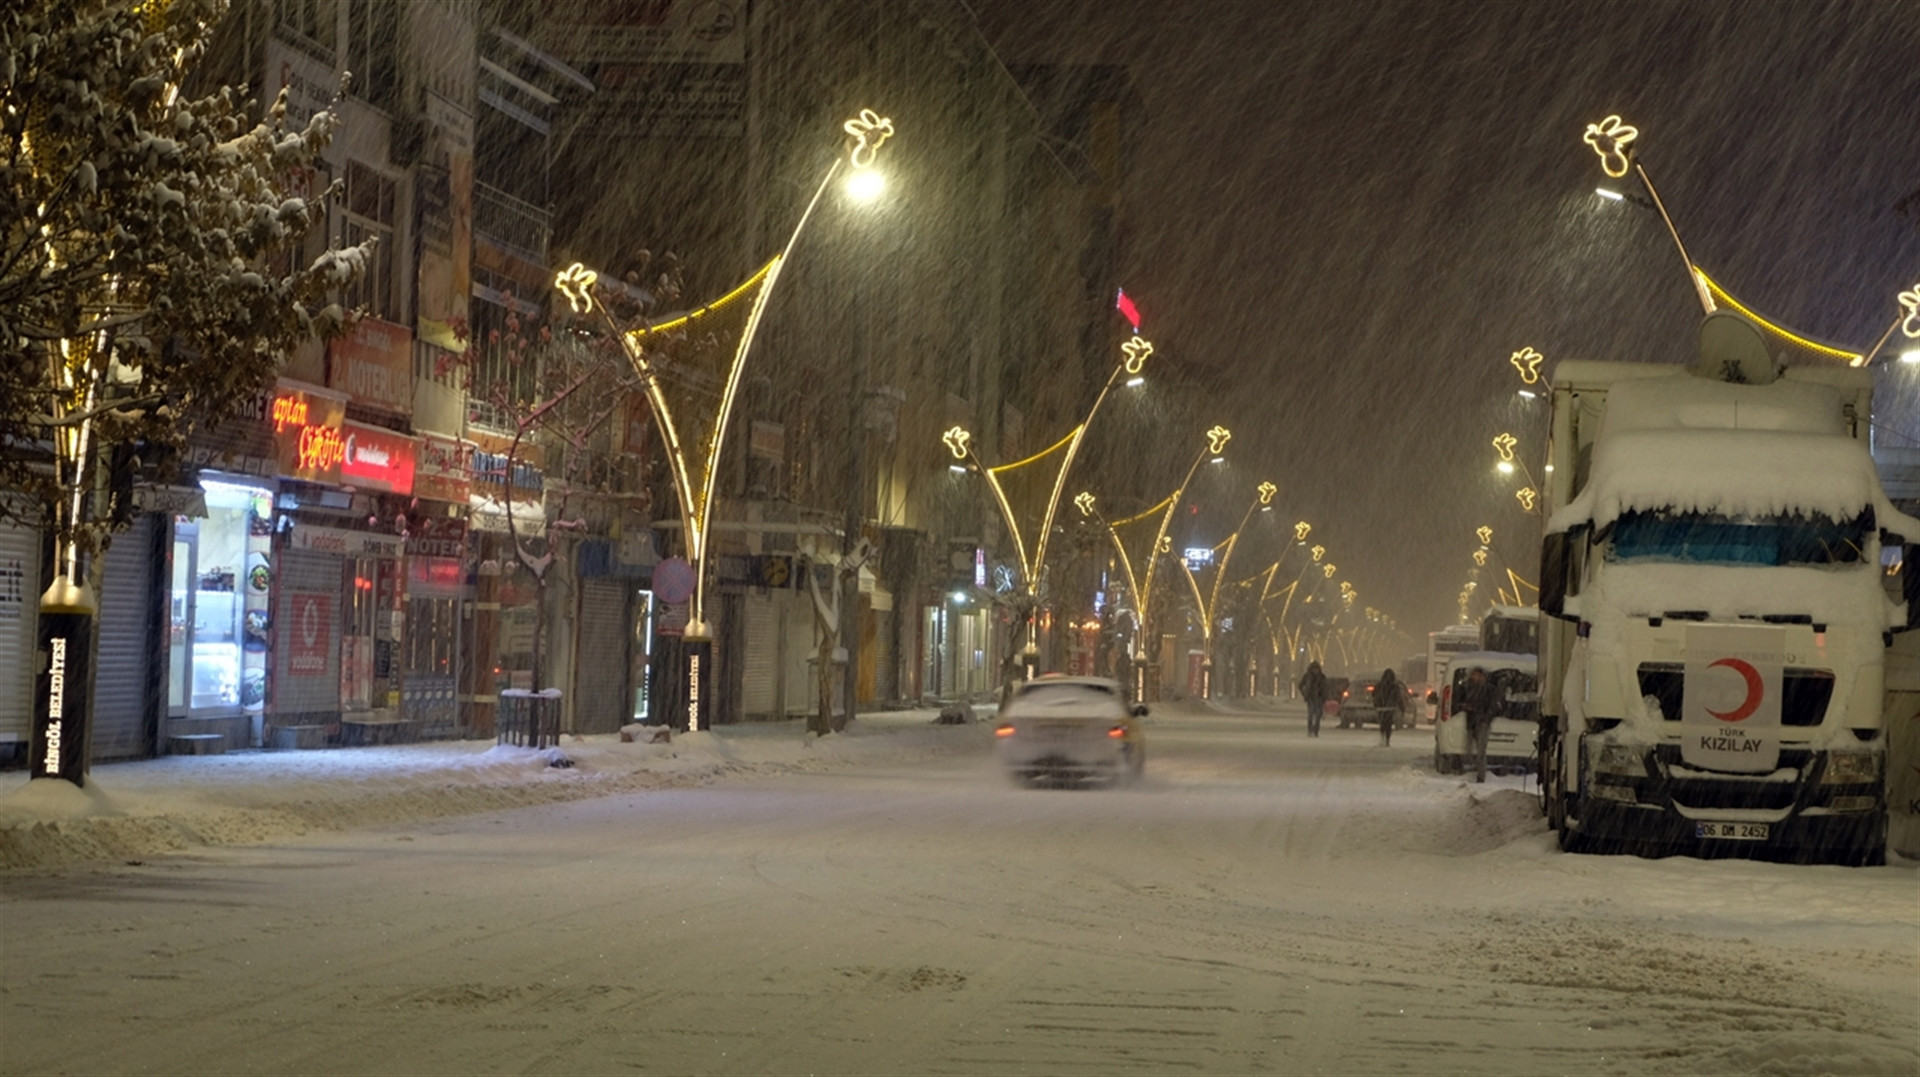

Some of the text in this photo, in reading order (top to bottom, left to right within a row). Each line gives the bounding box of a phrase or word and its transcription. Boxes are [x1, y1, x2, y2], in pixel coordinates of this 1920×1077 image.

[44, 637, 66, 774] BİNGÖL BELEDİYESİ
[1719, 727, 1745, 737] TÜRK
[1701, 736, 1762, 752] KIZILAY
[1703, 824, 1716, 836] 06
[1741, 825, 1767, 837] 2452
